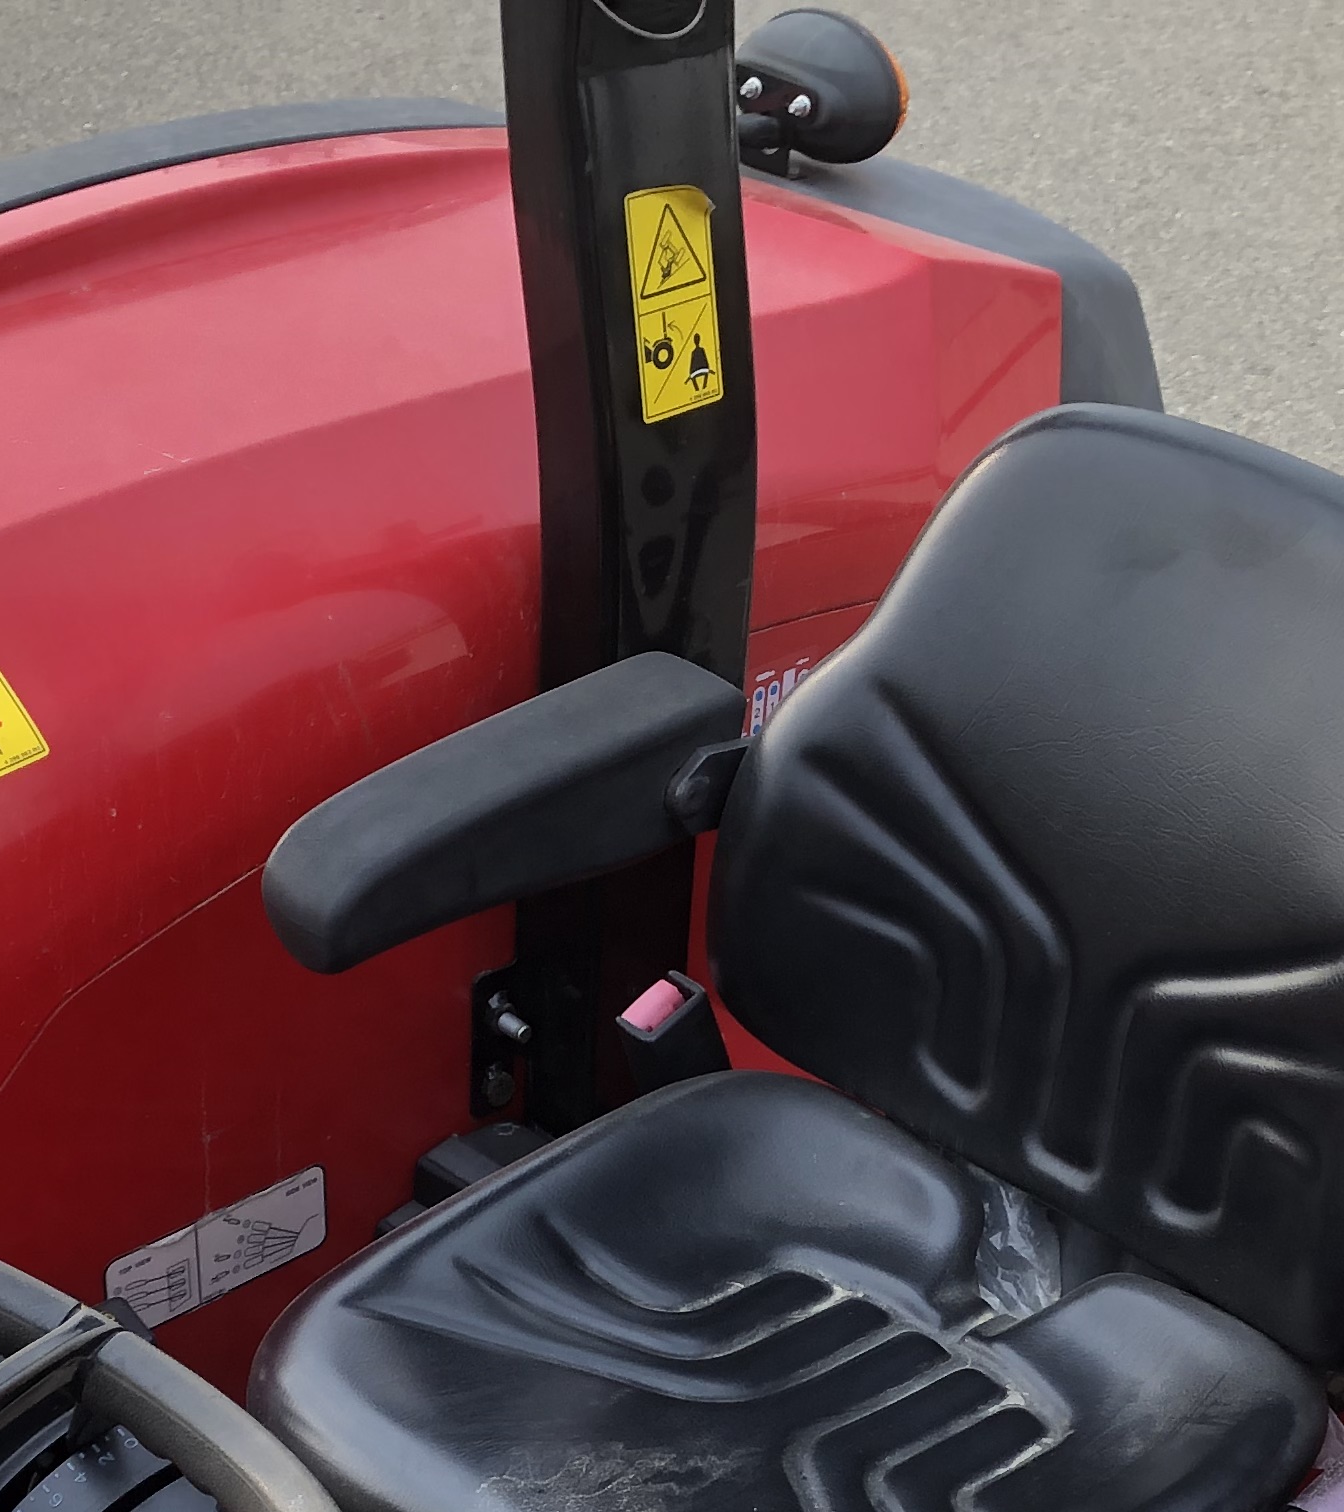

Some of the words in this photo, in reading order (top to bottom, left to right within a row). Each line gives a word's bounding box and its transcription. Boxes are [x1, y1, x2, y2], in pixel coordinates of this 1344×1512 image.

[754, 708, 761, 718] 2
[118, 1265, 132, 1276] TOP
[134, 1256, 152, 1269] VIEW
[124, 1437, 139, 1449] 0
[98, 1451, 115, 1466] 2
[74, 1472, 87, 1484] 4
